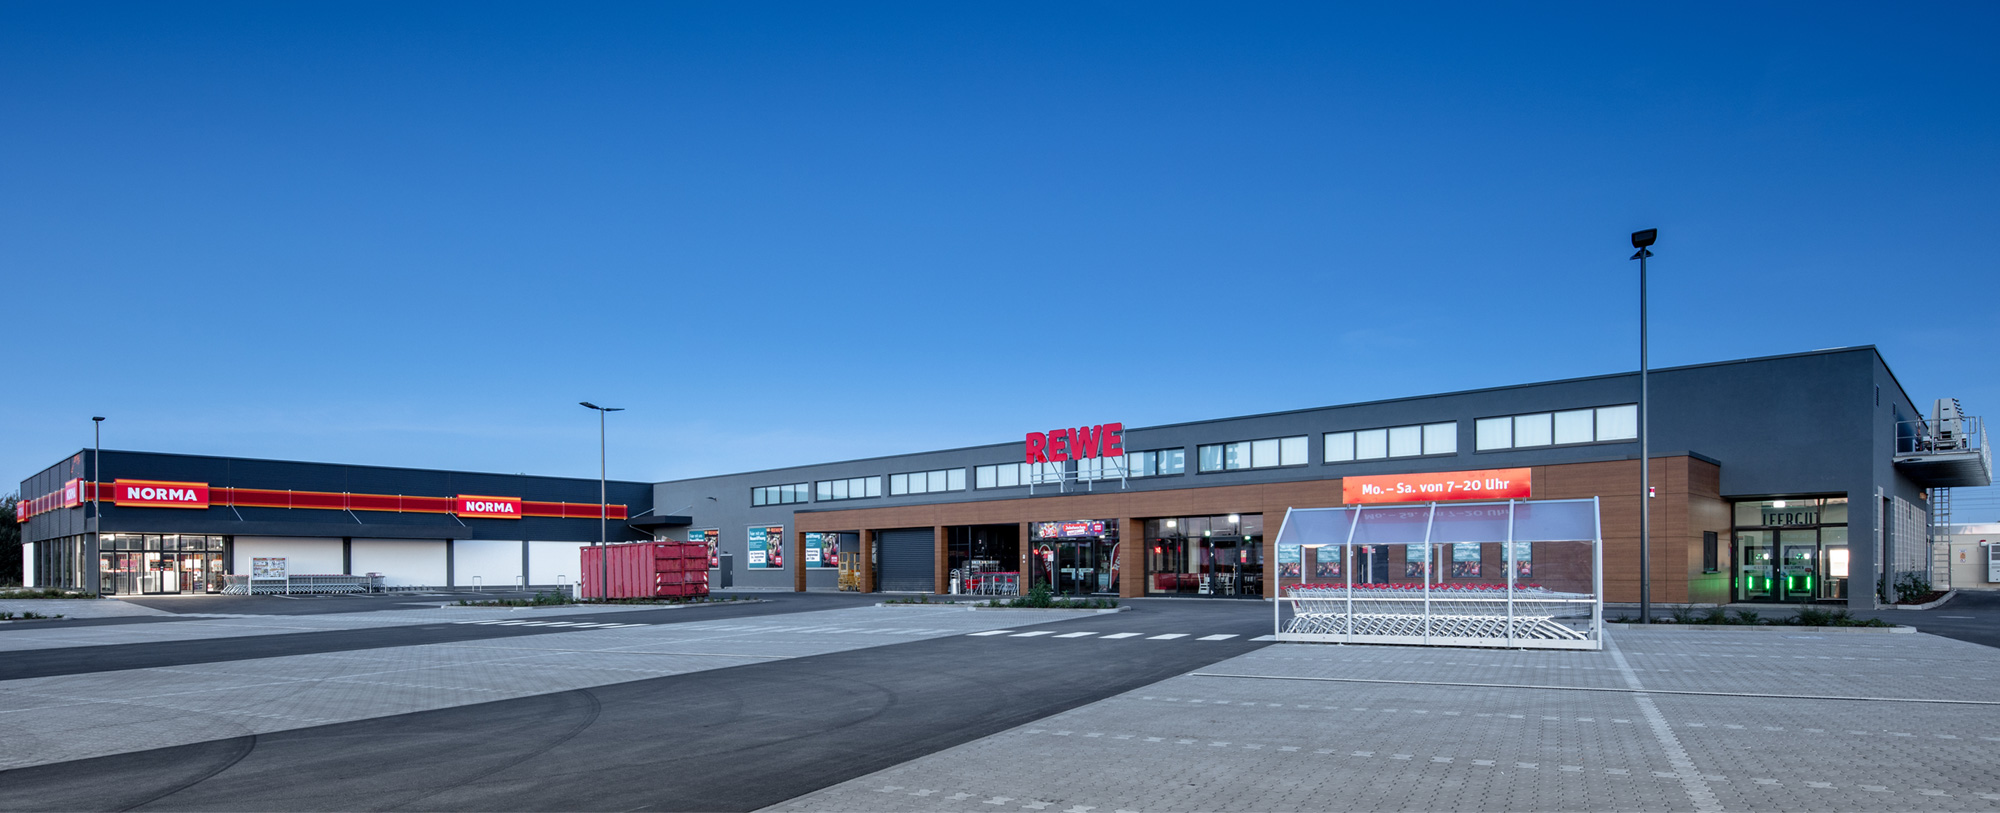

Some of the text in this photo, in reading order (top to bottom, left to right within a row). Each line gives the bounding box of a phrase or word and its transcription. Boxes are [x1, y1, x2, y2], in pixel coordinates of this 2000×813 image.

[1026, 422, 1124, 464] REWE
[127, 487, 198, 502] NORMA
[1362, 484, 1385, 495] Mo.
[1397, 483, 1416, 494] Sa.
[1420, 483, 1443, 493] von
[1447, 480, 1481, 493] 7–20
[1485, 478, 1510, 491] Uhr
[466, 501, 514, 513] NORMA
